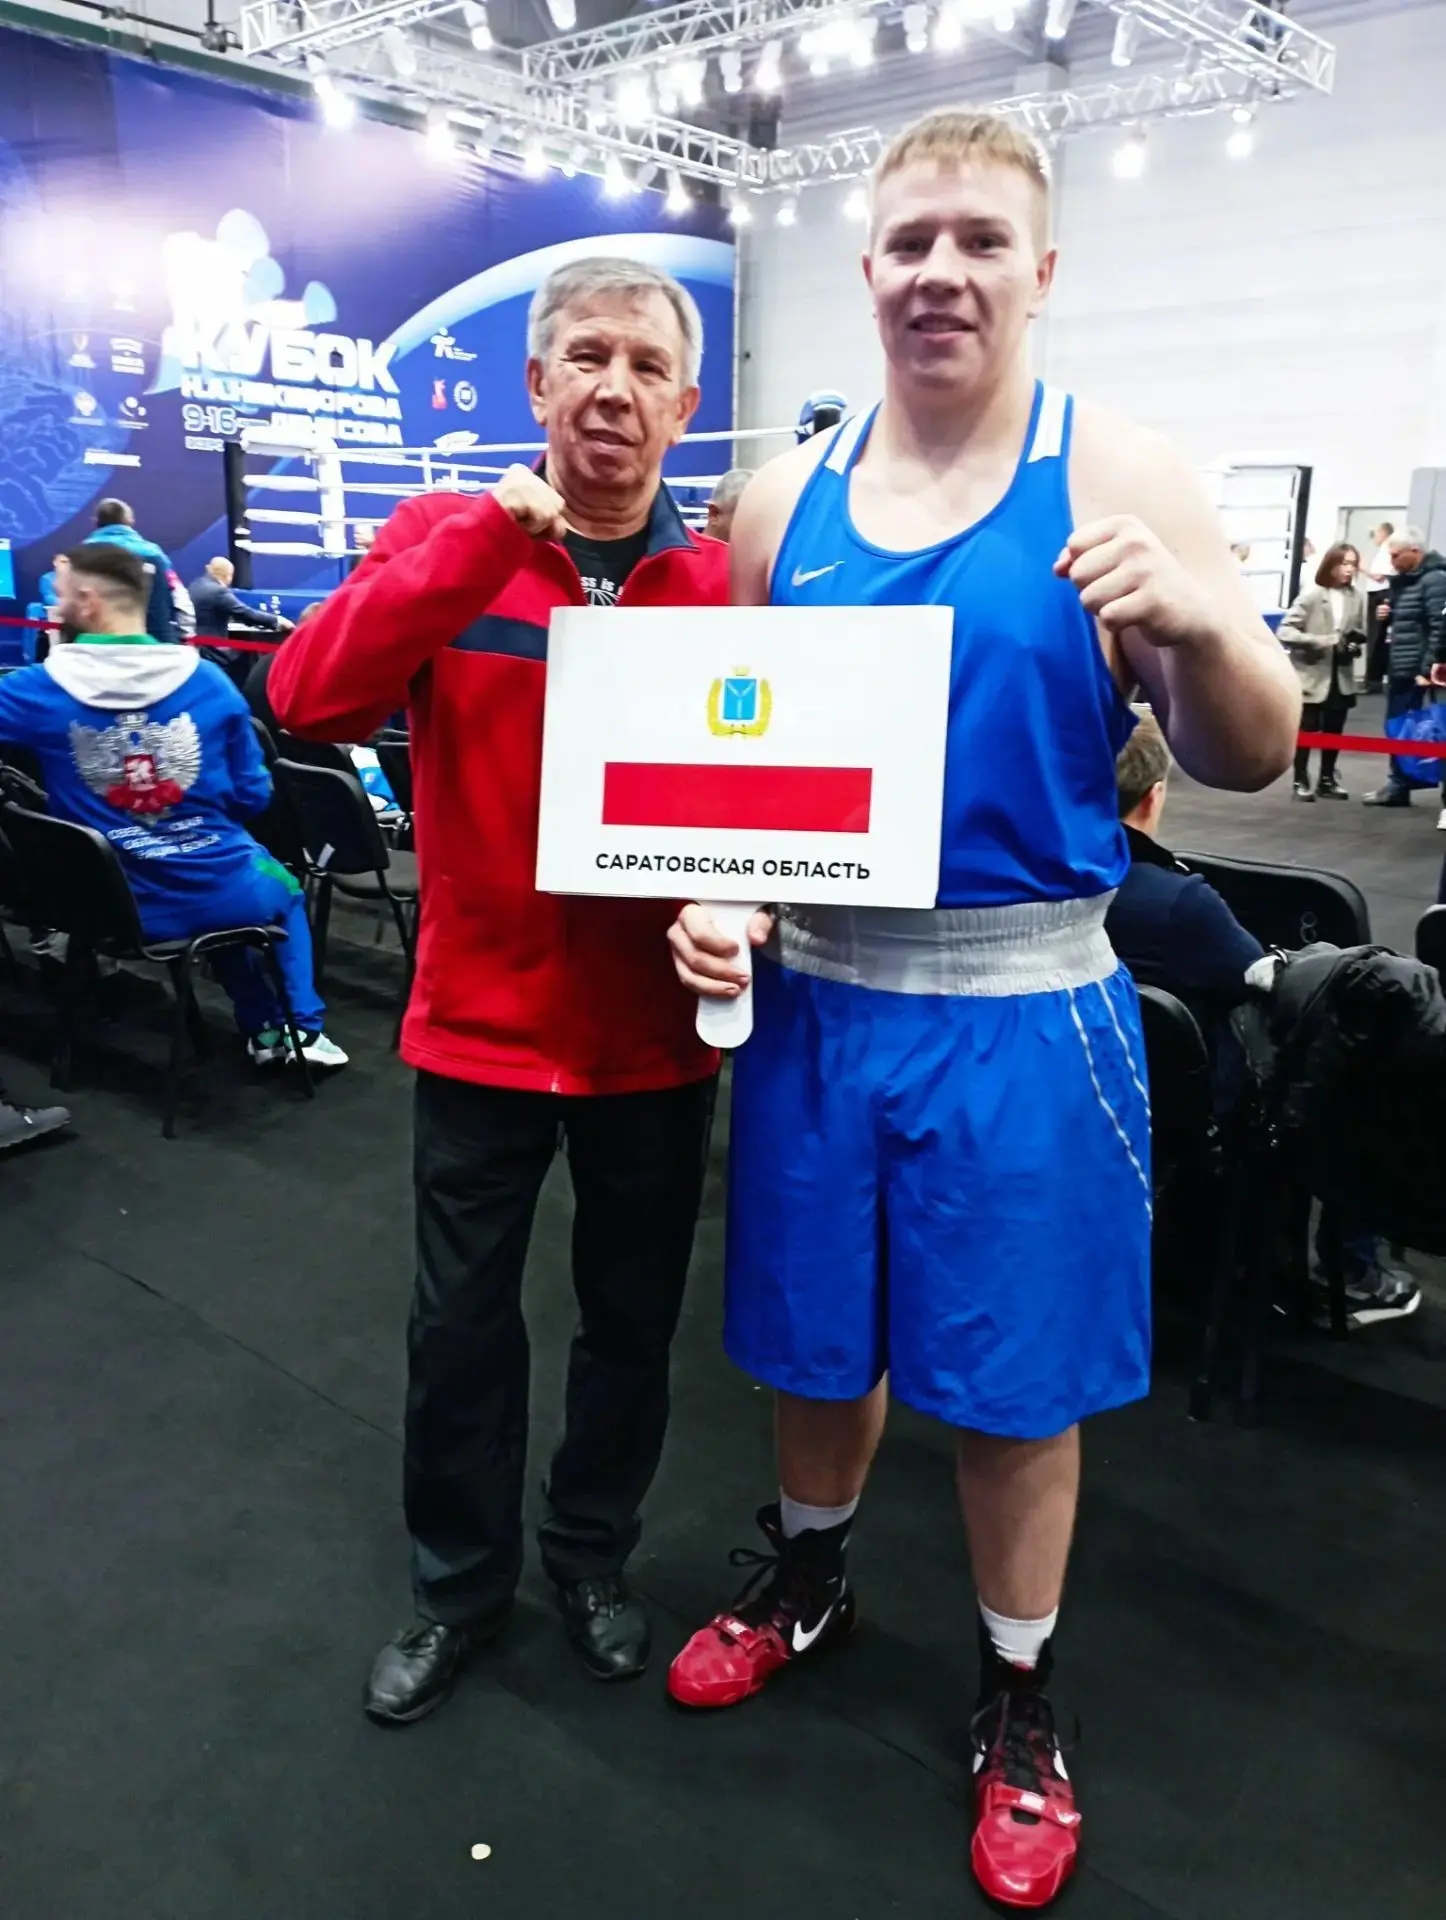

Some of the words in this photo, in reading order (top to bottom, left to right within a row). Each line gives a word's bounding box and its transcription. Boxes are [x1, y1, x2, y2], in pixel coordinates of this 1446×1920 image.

[178, 314, 401, 394] КУБОК
[595, 853, 755, 875] САРАТОВСКАЯ
[762, 860, 871, 880] ОБЛАСТЬ
